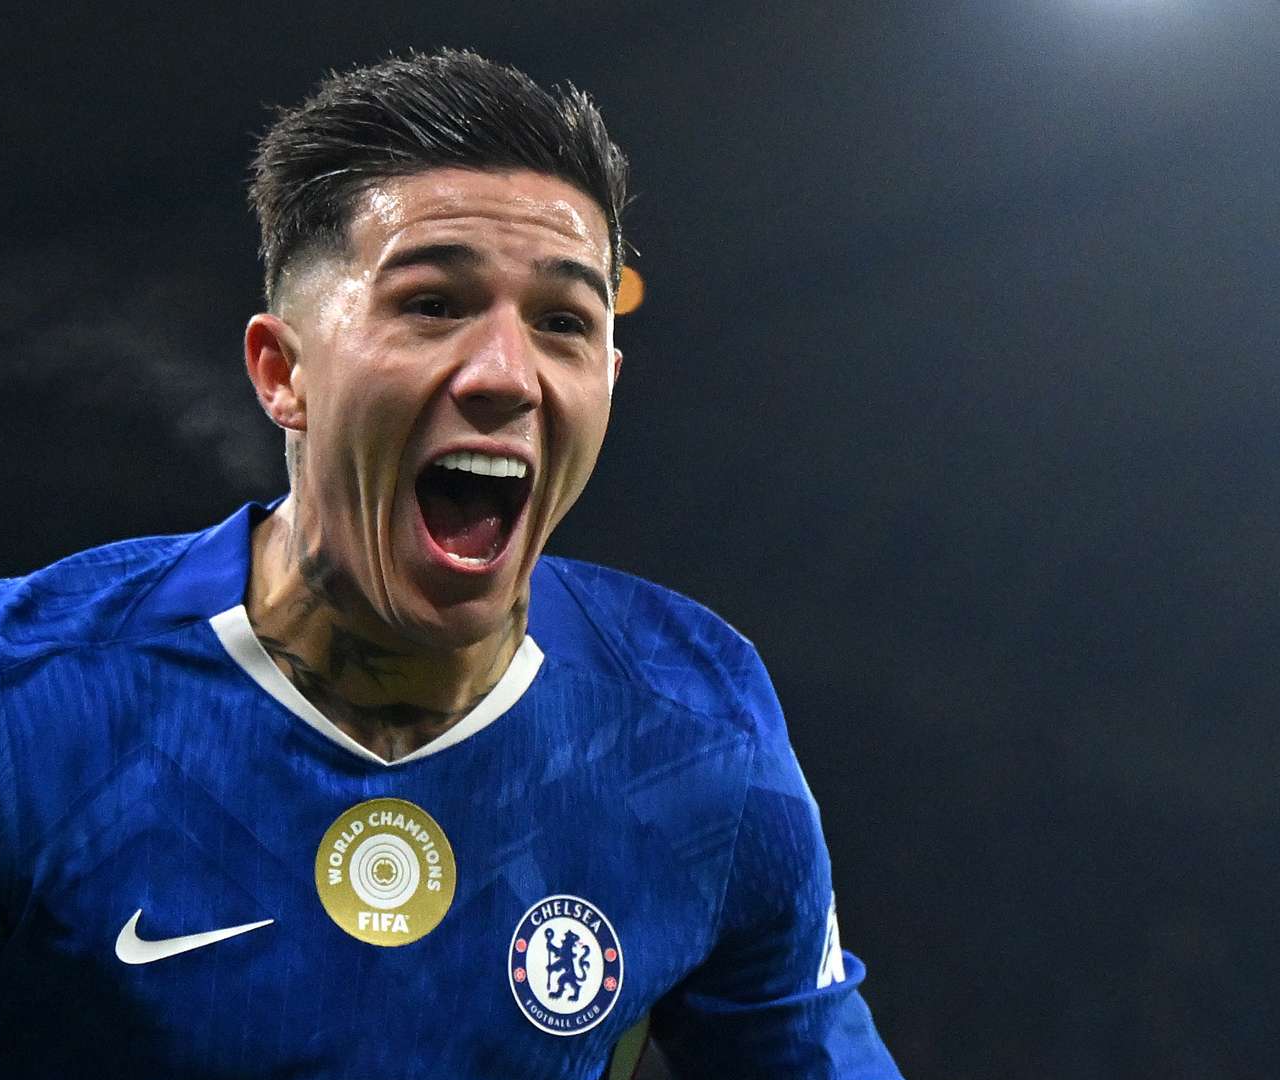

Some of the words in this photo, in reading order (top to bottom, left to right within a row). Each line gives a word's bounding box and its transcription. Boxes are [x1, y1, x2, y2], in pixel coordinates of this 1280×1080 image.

[329, 819, 364, 885] WORLD
[368, 811, 442, 892] CHAMPIONS
[358, 911, 409, 933] FIFA
[530, 900, 601, 934] CHELSEA
[525, 999, 571, 1028] FOOTBALL
[575, 1004, 601, 1026] CLUB
